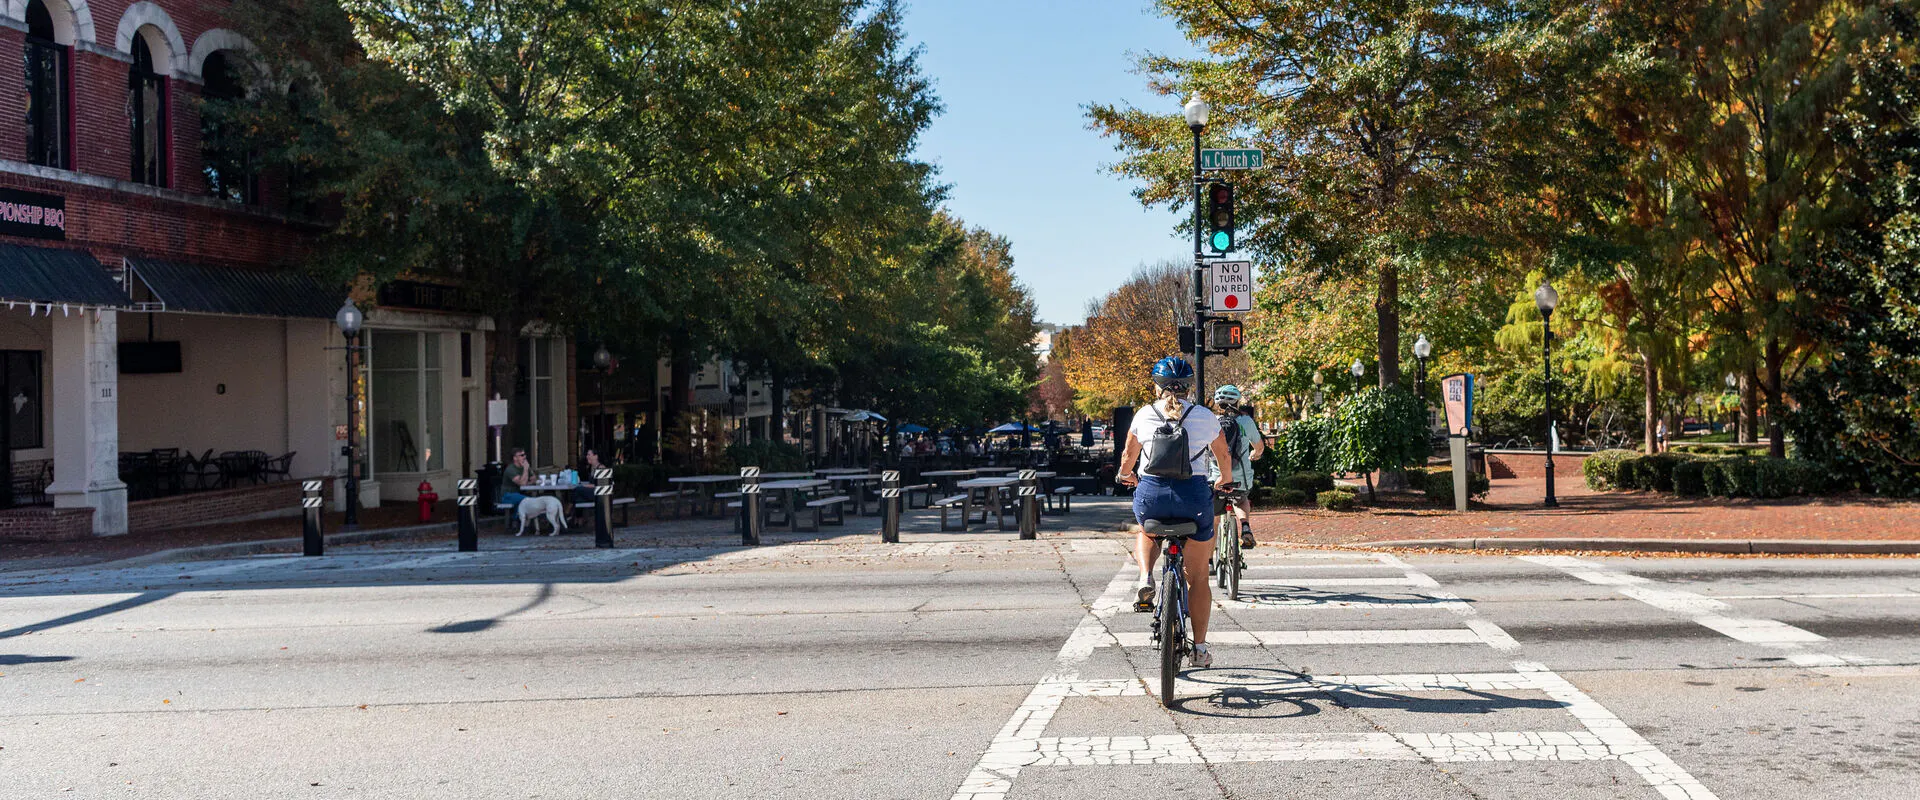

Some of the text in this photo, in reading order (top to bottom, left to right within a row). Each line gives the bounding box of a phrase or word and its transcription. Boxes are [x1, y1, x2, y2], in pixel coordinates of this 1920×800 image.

[1205, 151, 1259, 167] N Church St
[44, 207, 65, 231] BBQ
[1221, 263, 1240, 273] NO
[1219, 274, 1243, 283] TURN
[1214, 284, 1248, 293] ON RED
[414, 286, 437, 305] THE
[1230, 326, 1241, 345] 19
[102, 387, 112, 398] 111
